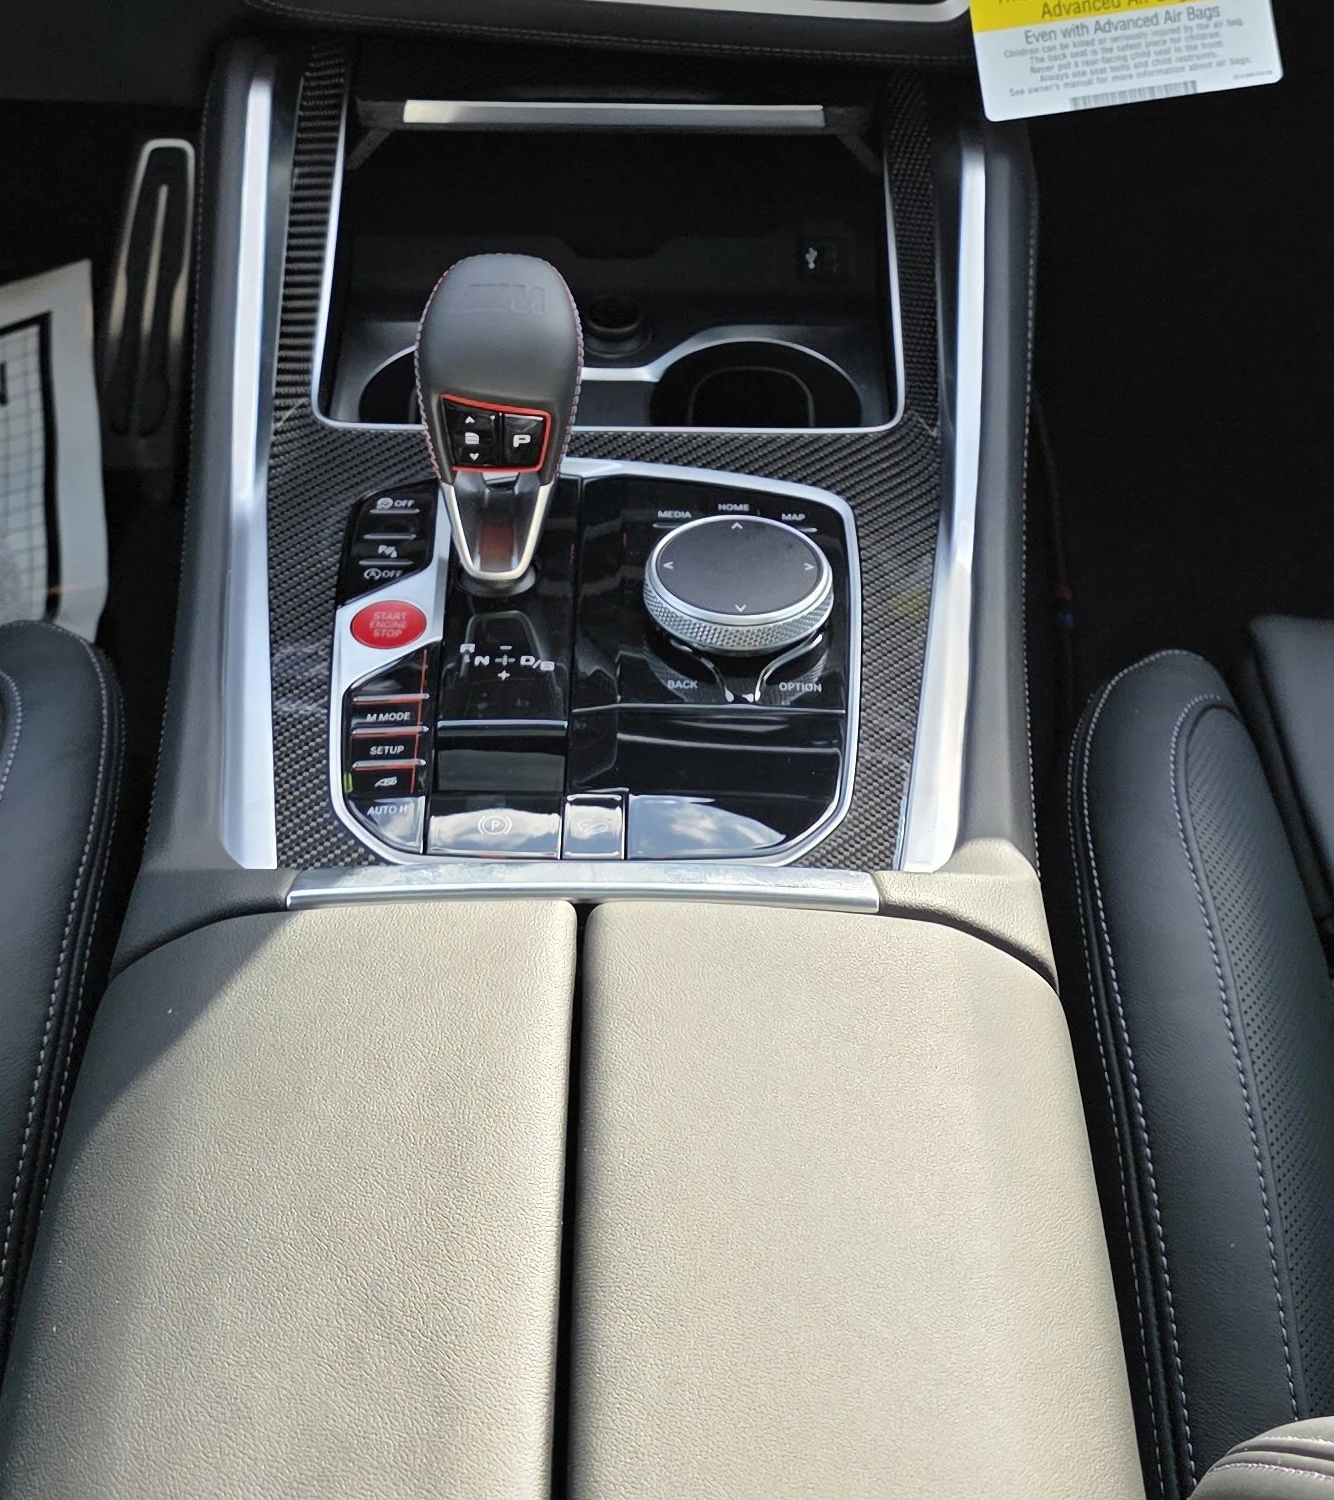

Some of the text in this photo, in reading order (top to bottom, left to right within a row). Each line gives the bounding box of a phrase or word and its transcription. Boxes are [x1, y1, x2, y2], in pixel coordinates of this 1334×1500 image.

[1025, 5, 1221, 45] Even with Advanced Air Bags
[513, 434, 531, 448] P
[394, 499, 416, 507] OFF
[717, 503, 750, 512] HOME
[657, 510, 692, 519] MEDIA
[781, 513, 806, 521] MAP
[381, 570, 403, 578] OFF
[373, 612, 408, 620] START
[369, 620, 408, 629] ENGINE
[373, 629, 404, 638] STOP
[474, 655, 490, 666] N
[667, 679, 698, 689] BACK
[778, 681, 822, 693] OPTION
[367, 711, 411, 722] M MODE
[370, 745, 405, 755] SETUP
[367, 804, 409, 816] AUTO H
